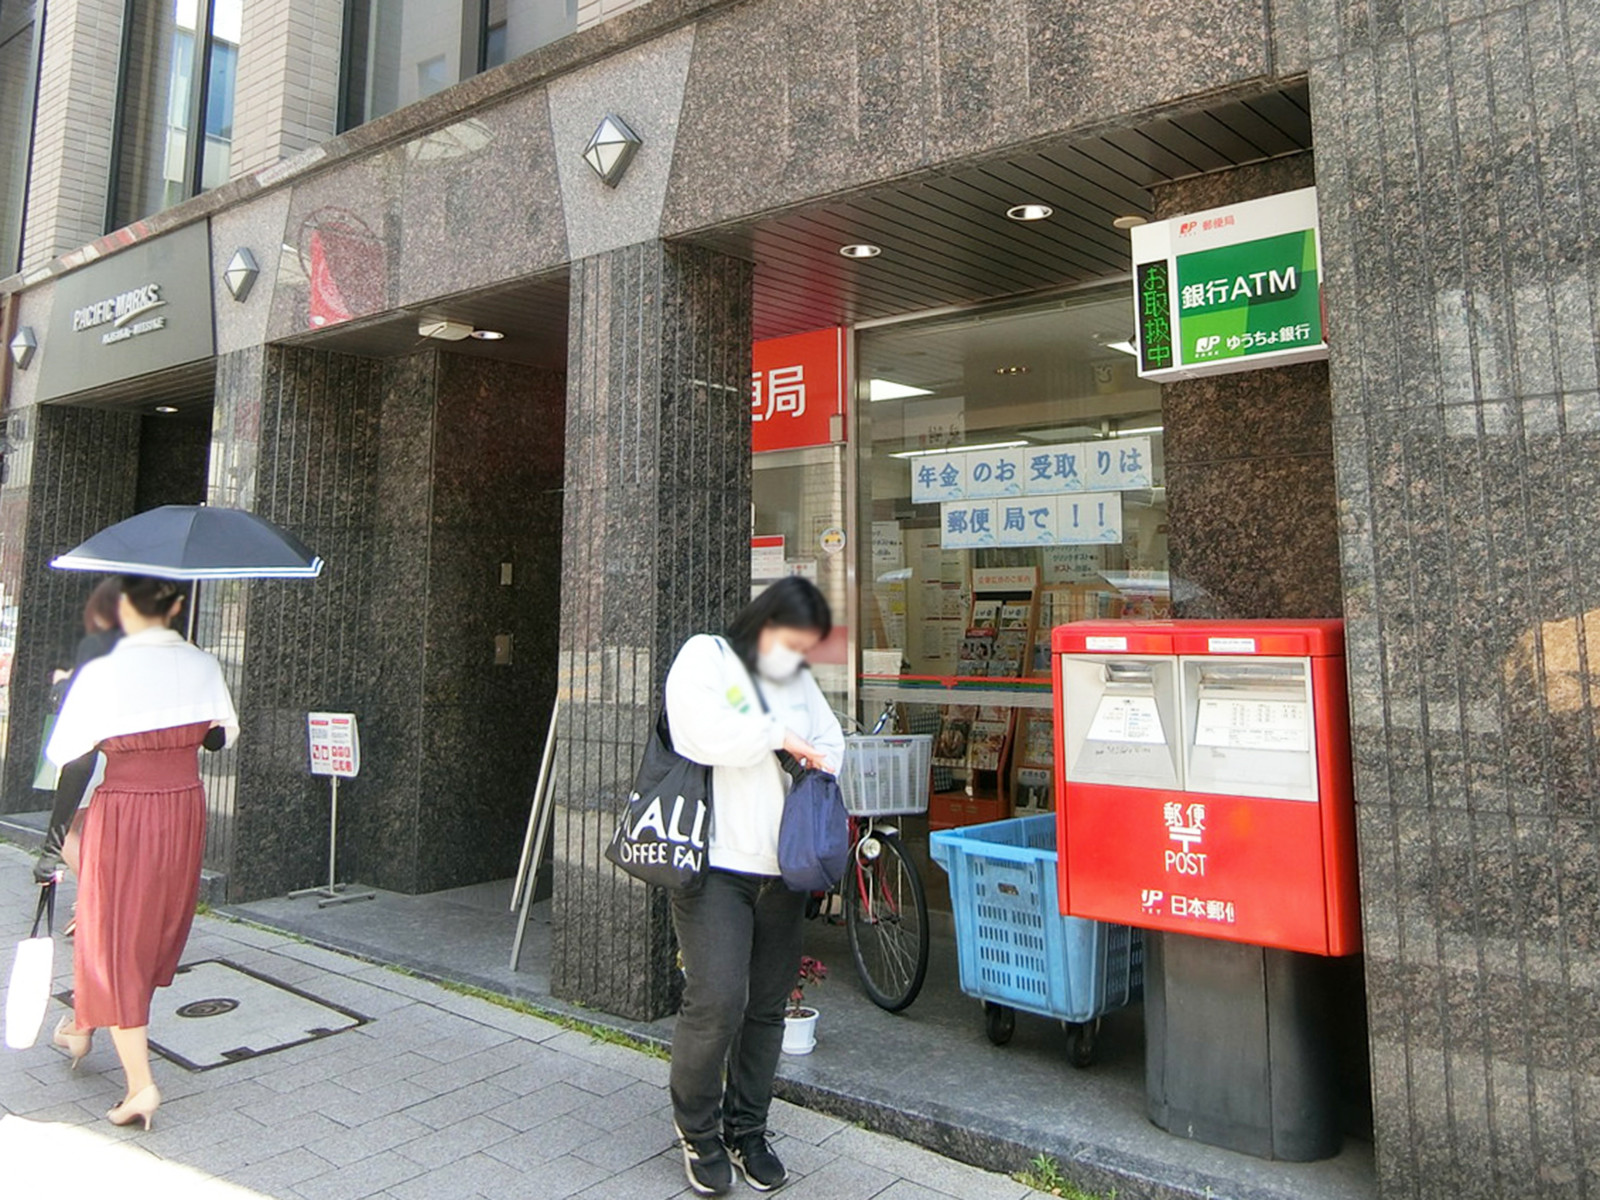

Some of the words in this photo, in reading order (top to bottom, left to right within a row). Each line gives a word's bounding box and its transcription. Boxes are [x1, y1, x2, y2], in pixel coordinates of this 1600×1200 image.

[1202, 215, 1235, 231] 郵便局
[1181, 266, 1297, 309] 銀行ATM
[73, 299, 116, 332] PACIFIC
[115, 283, 159, 318] MARKS
[1143, 265, 1171, 367] お取扱中
[1226, 323, 1311, 351] ゆうちょ銀行
[918, 447, 1143, 488] 年金のお受取りは
[613, 791, 707, 848] ALL
[1163, 801, 1206, 830] 郵便
[620, 840, 668, 865] OFFEE
[1164, 850, 1207, 877] POST
